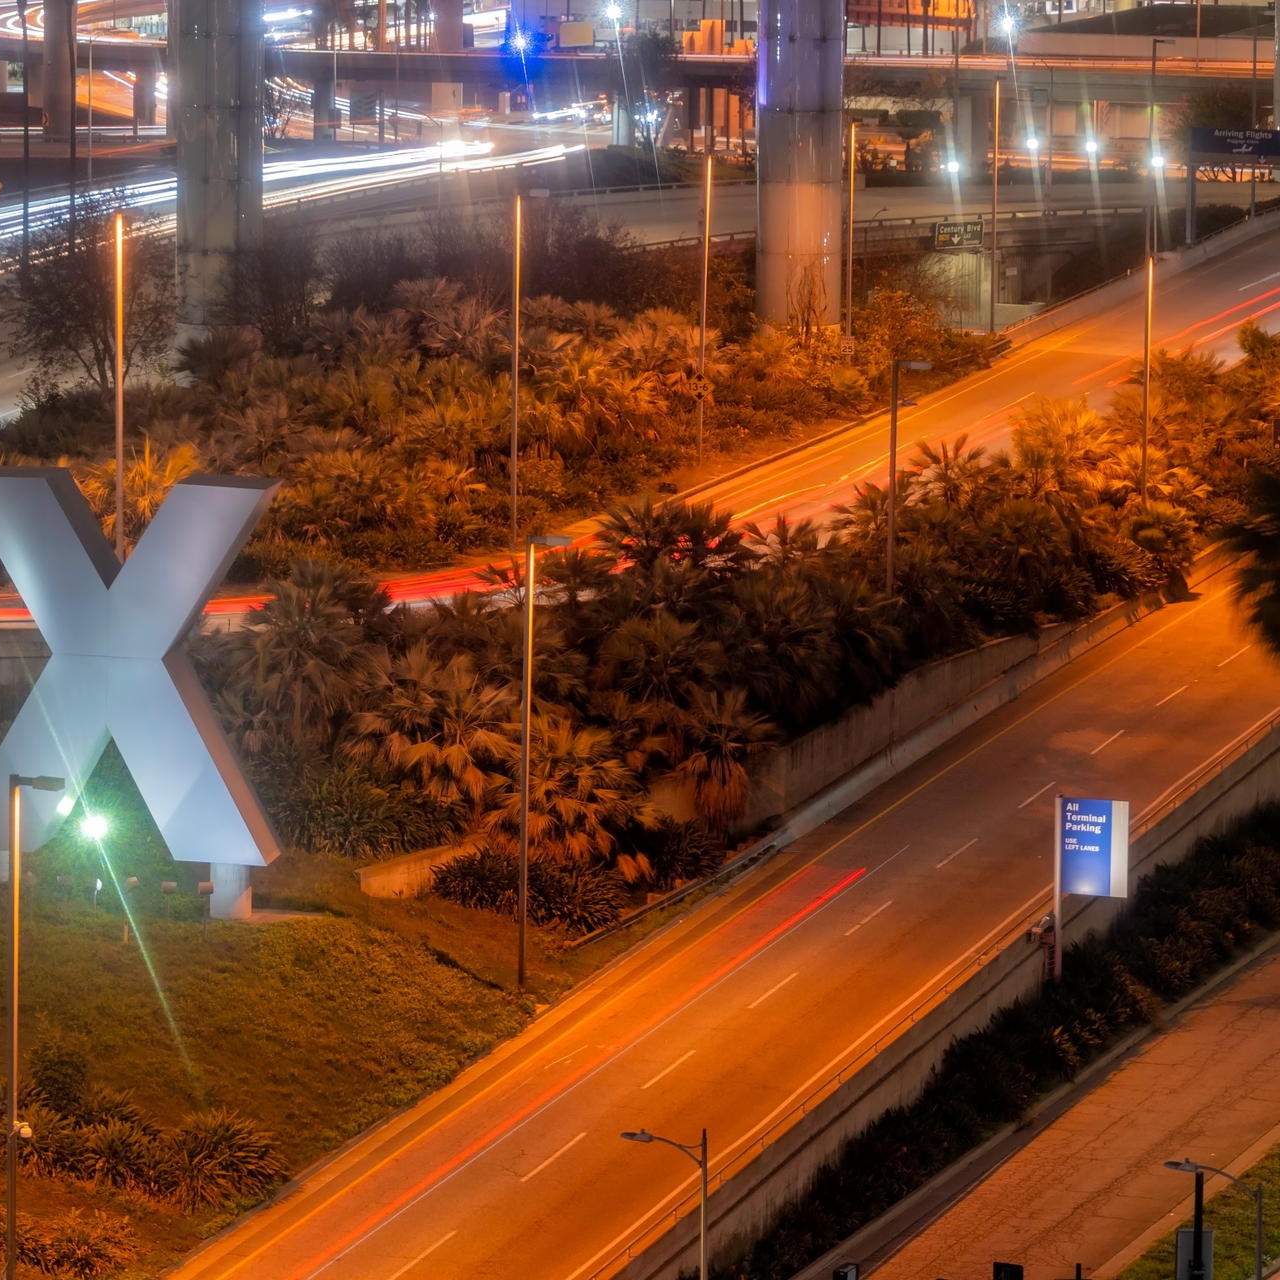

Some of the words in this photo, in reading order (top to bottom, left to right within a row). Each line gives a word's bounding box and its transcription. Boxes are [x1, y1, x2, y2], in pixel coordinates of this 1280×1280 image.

[1214, 129, 1244, 139] Arriving
[1246, 131, 1272, 140] Flights
[842, 345, 853, 353] 25
[1066, 803, 1080, 812] All
[1066, 813, 1106, 823] Terminal
[1065, 823, 1102, 834] Parking
